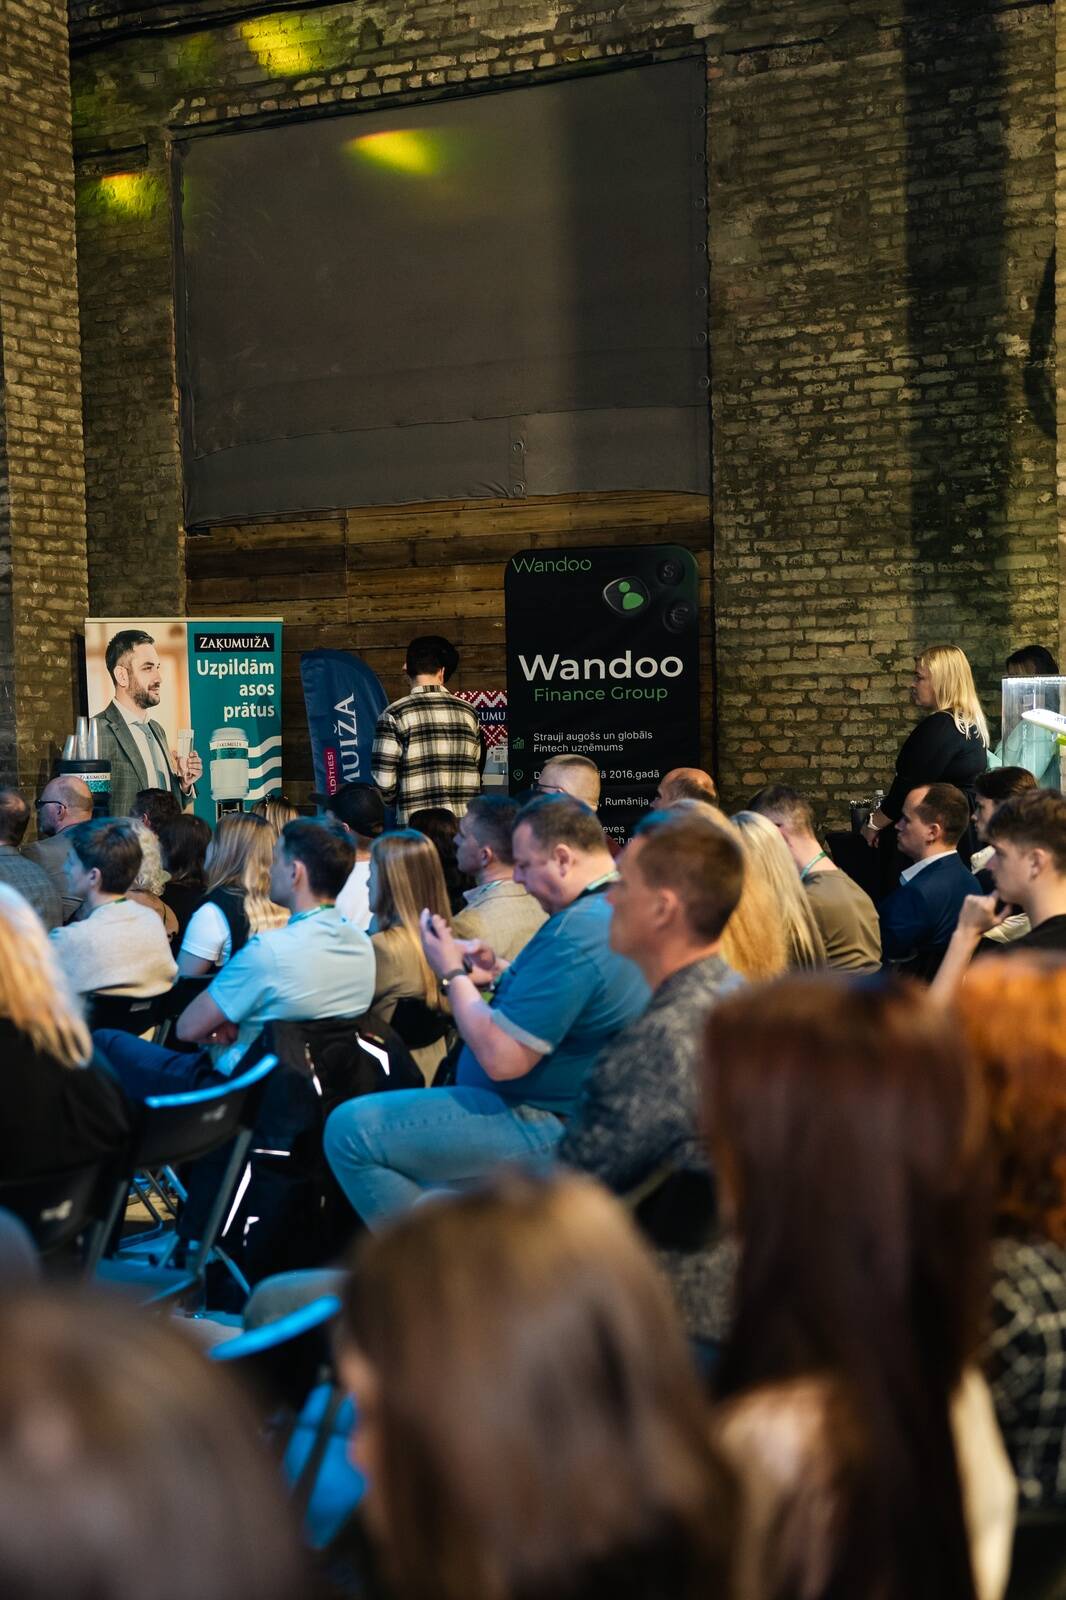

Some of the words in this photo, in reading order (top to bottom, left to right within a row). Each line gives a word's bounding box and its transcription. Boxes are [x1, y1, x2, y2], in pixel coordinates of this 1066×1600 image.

[512, 556, 592, 574] Wandoo
[200, 635, 270, 651] ZAĶUMUIŽA
[196, 658, 275, 679] Uzpildām
[518, 650, 684, 681] Wandoo
[239, 683, 275, 697] asos
[534, 688, 606, 702] Finance
[611, 686, 668, 702] Group
[223, 702, 275, 722] prātus
[478, 711, 506, 721] UMU
[533, 732, 564, 742] Strauji
[566, 732, 600, 742] augošs
[603, 732, 615, 740] un
[618, 730, 653, 741] globāls
[533, 744, 568, 752] Fintech
[609, 769, 660, 780] 2016.gadā
[605, 796, 649, 807] Rumānija
[602, 825, 625, 833] eves
